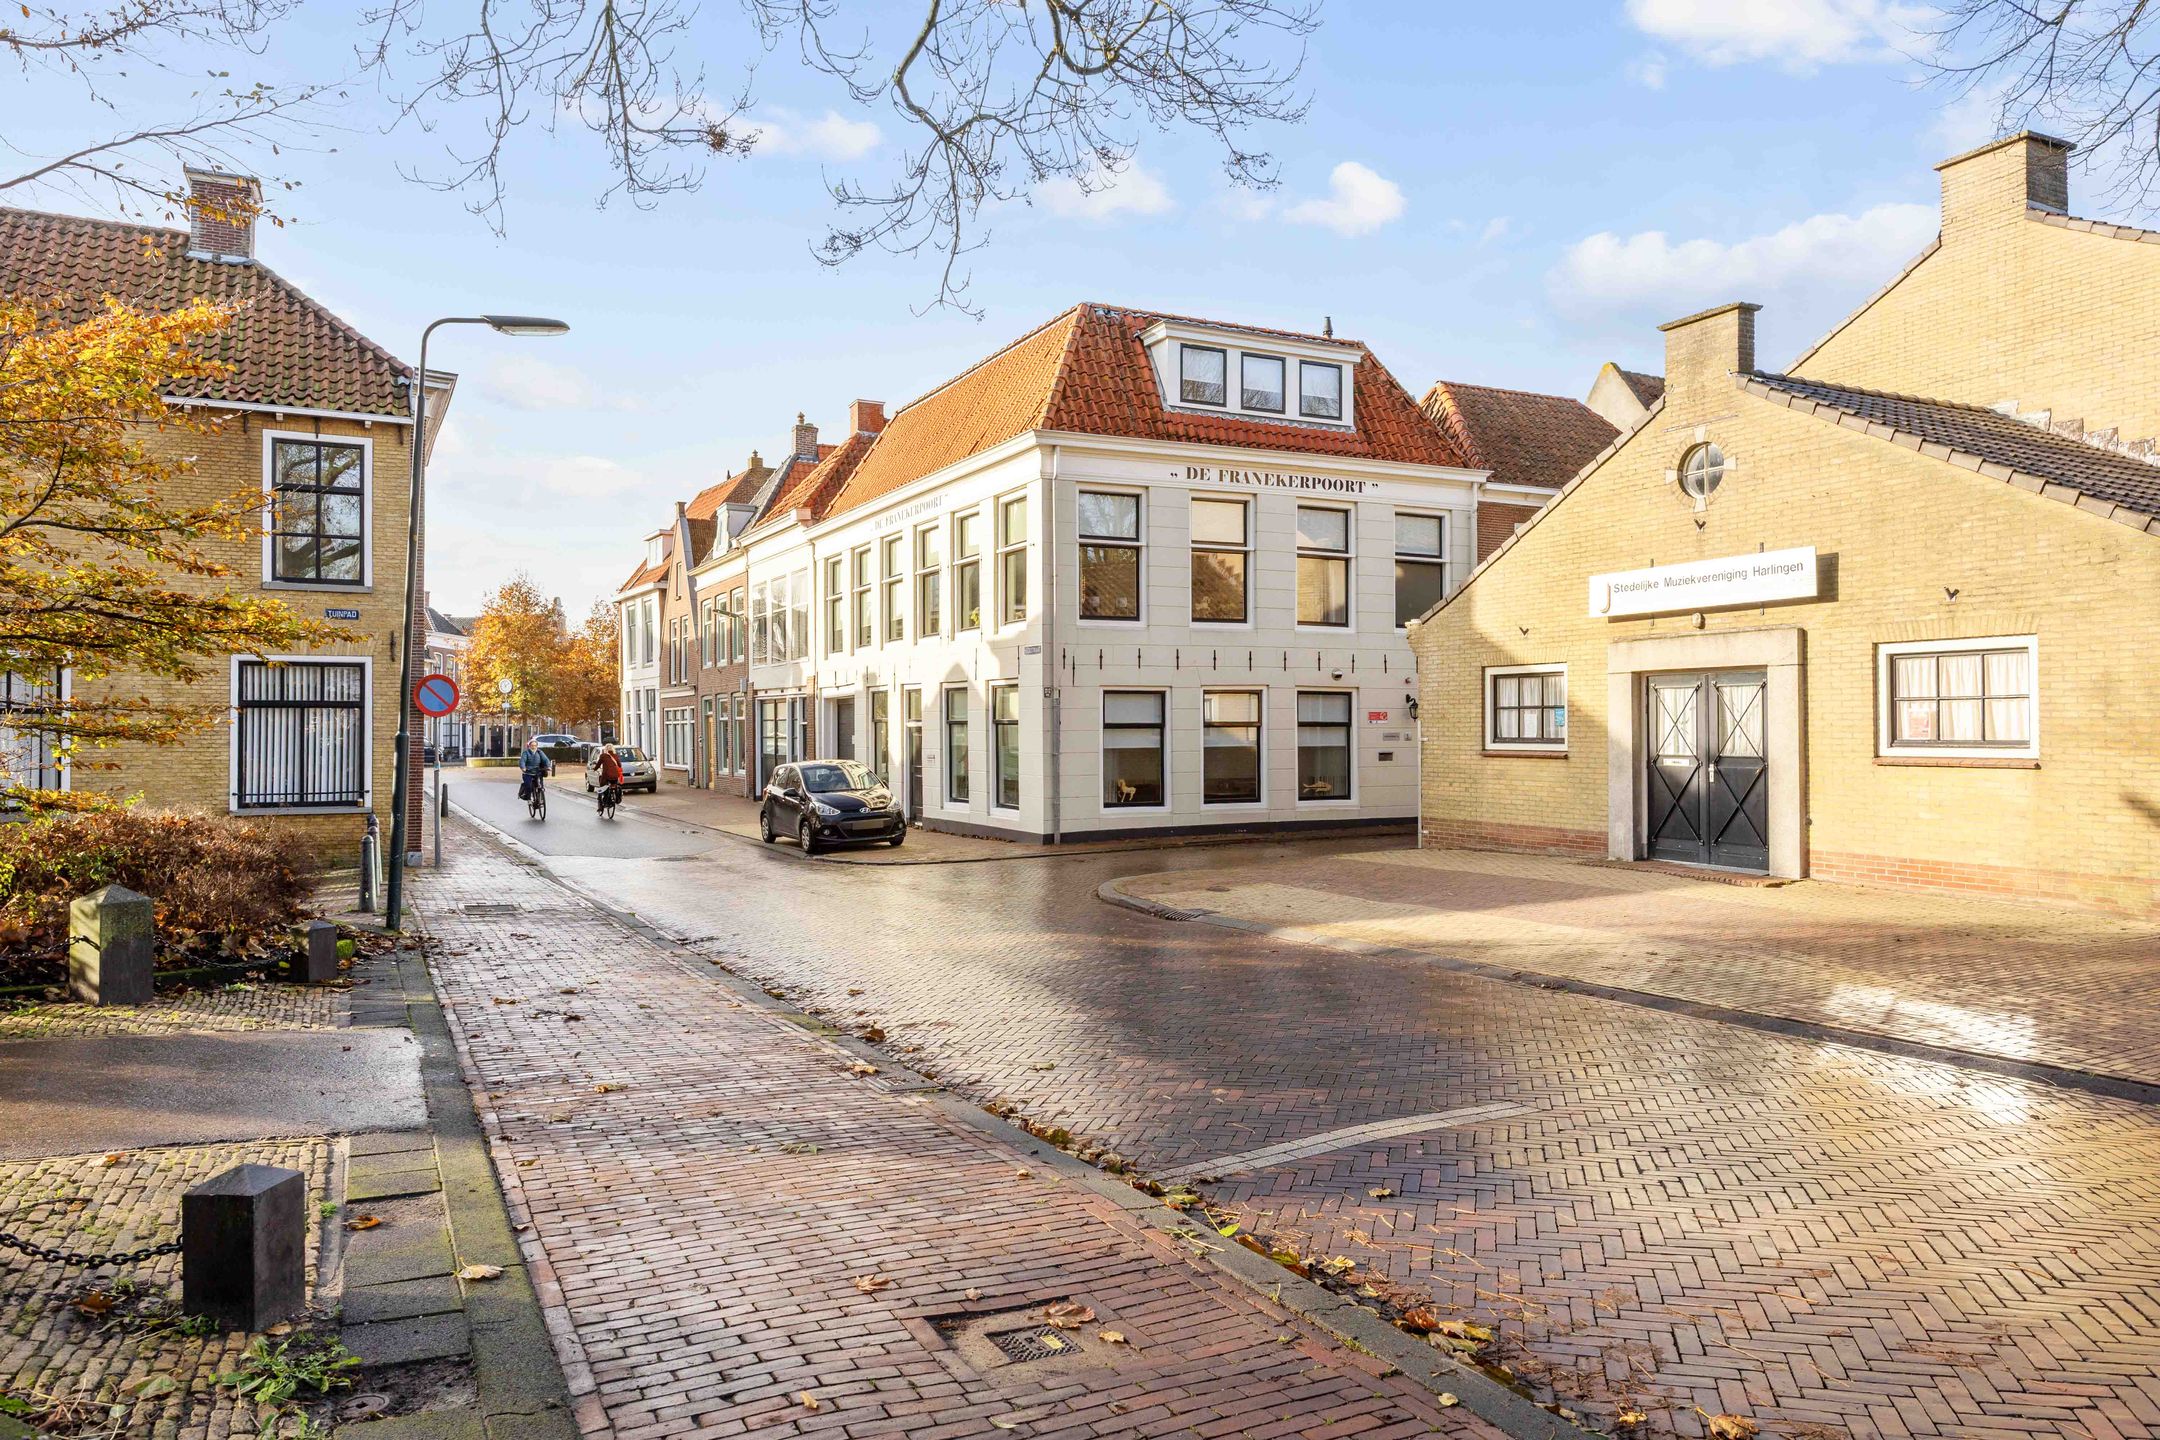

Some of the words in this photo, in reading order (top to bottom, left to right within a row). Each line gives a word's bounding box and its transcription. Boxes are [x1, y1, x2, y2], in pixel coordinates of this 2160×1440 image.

[1186, 466, 1210, 481] DE
[1218, 469, 1366, 494] FRANEKERPOORT
[1613, 579, 1660, 594] Stedelijke
[1663, 567, 1748, 588] Muziekvereniging
[1752, 561, 1804, 577] Harlingen
[327, 610, 357, 618] TUINPAD
